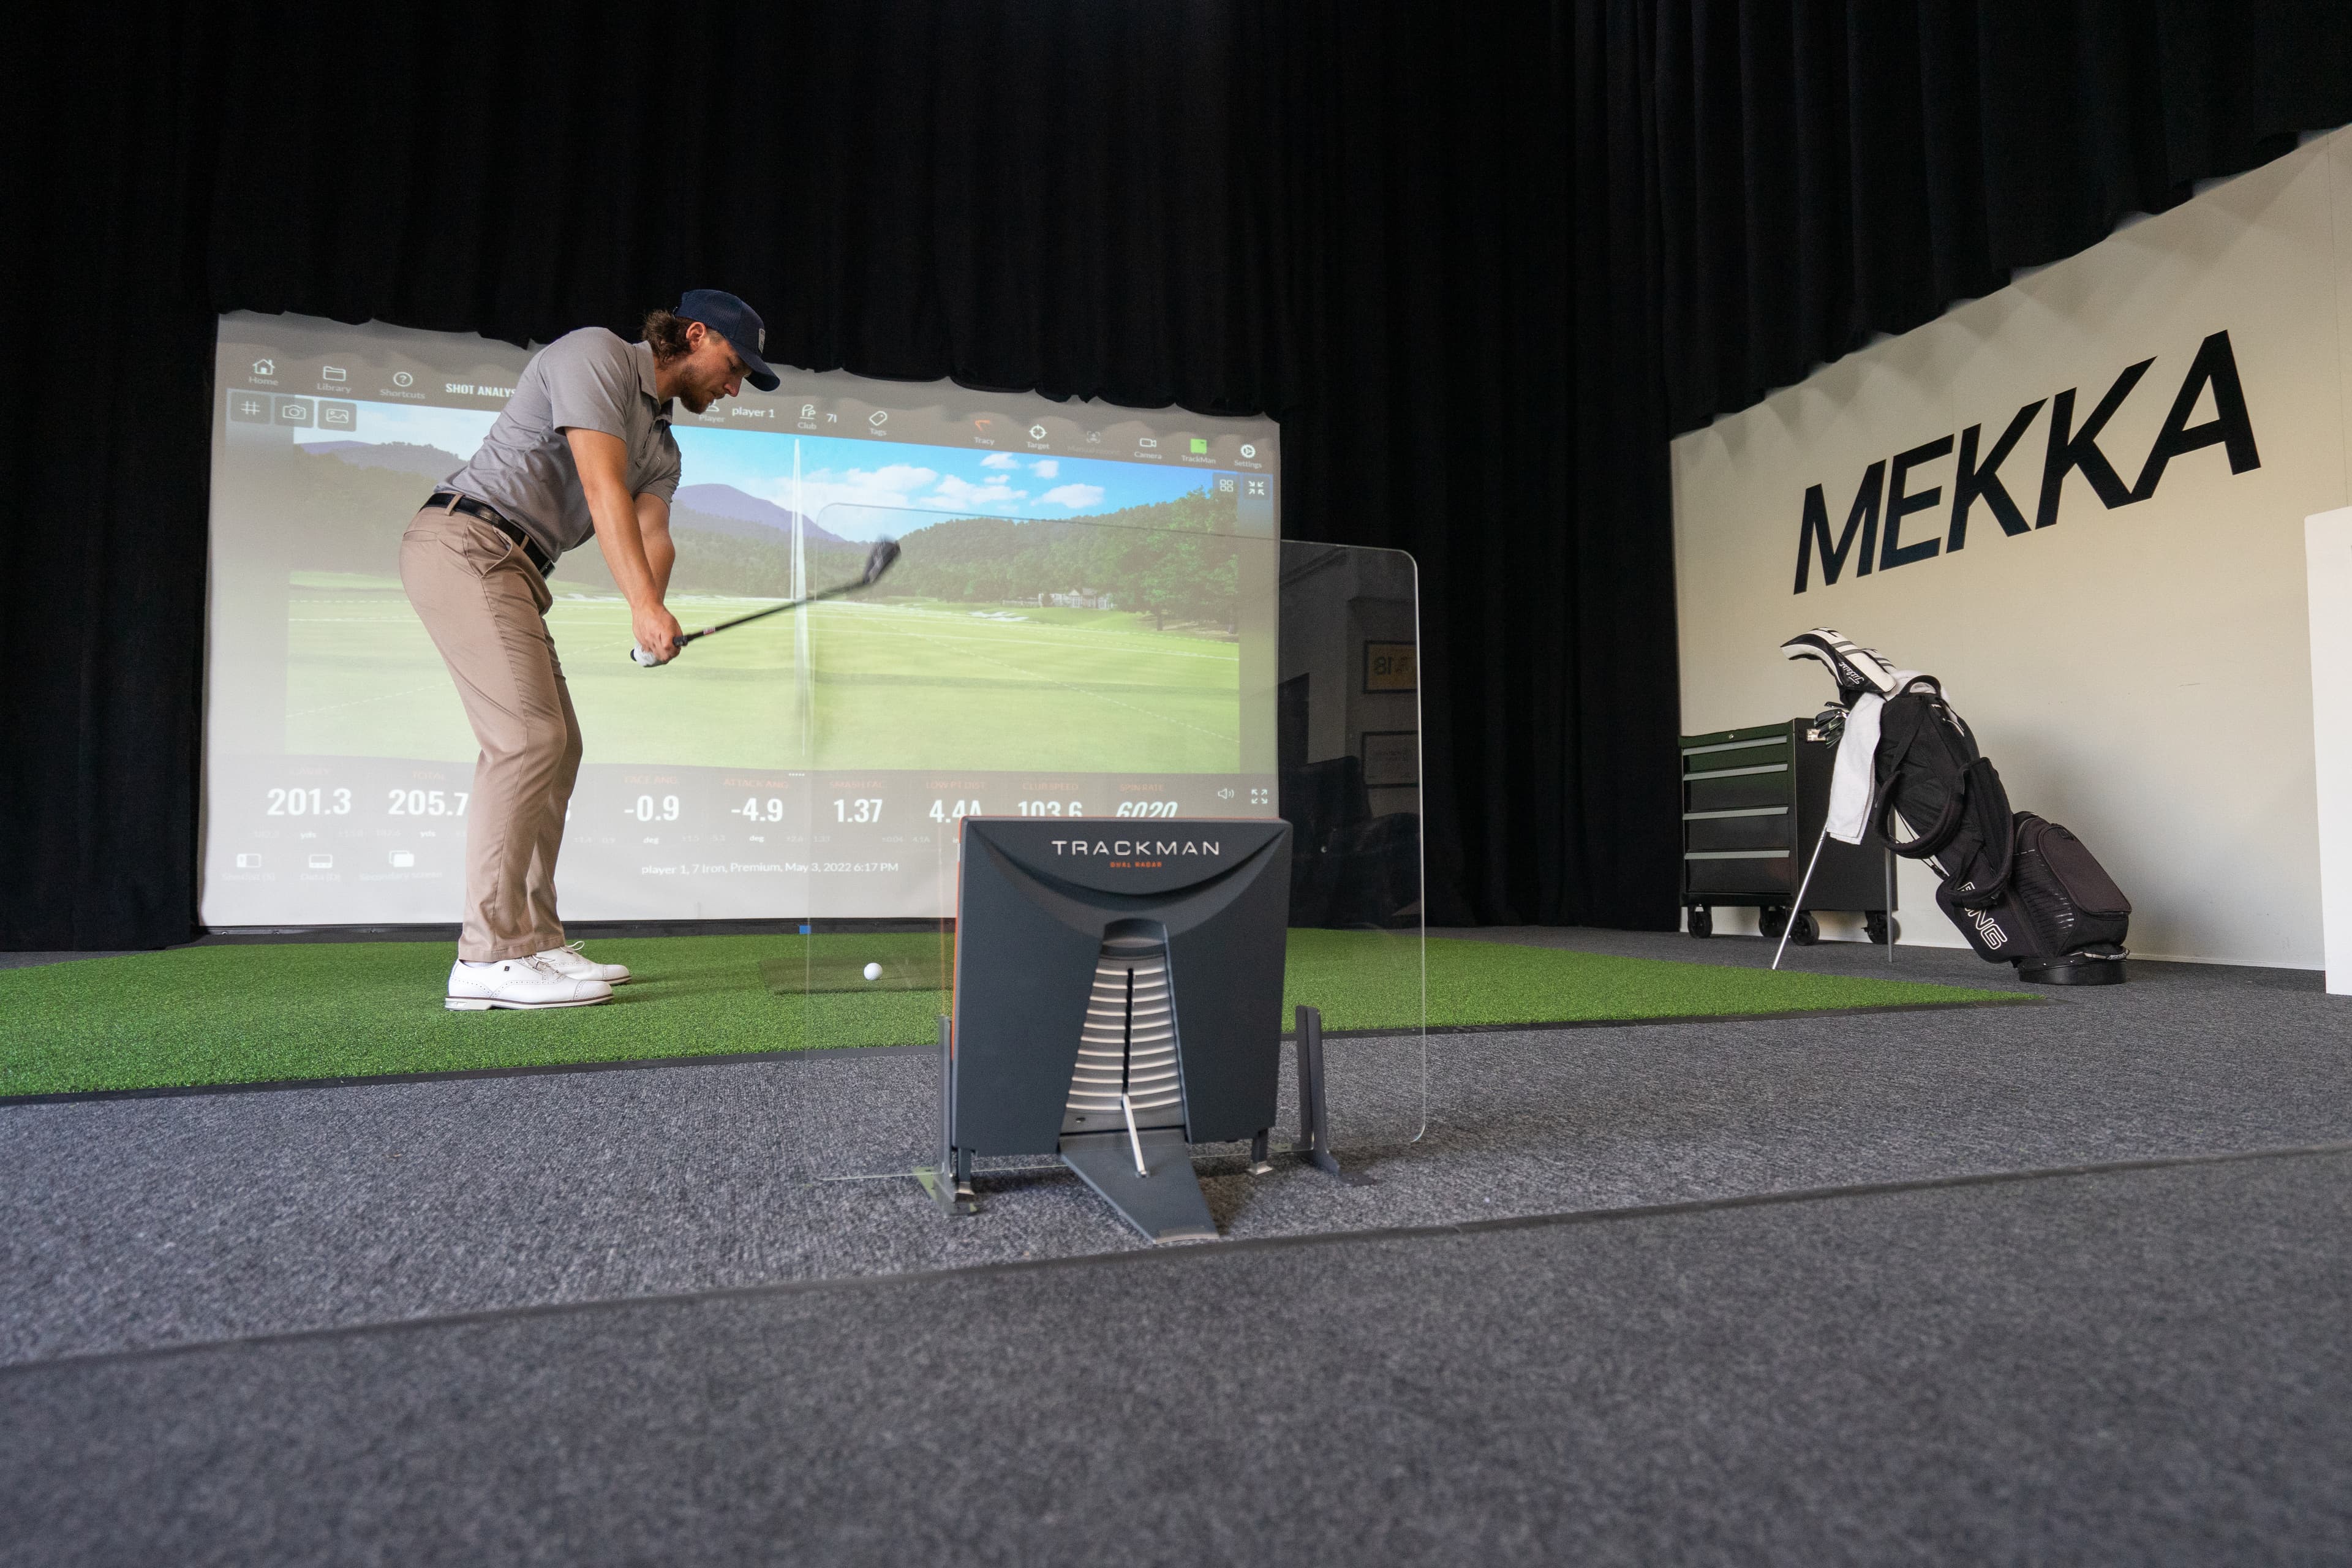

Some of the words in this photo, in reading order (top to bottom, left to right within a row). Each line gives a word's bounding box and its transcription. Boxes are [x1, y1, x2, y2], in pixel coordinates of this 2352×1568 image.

[249, 376, 279, 386] Home
[317, 383, 352, 394] Library
[380, 388, 426, 399] Shortcuts
[445, 383, 475, 394] SHOT
[732, 406, 765, 418] player
[769, 409, 775, 418] 1
[699, 414, 725, 423] Player
[797, 421, 816, 430] Club
[870, 428, 888, 437] Tags
[974, 436, 995, 446] Tracy
[1027, 441, 1050, 450] Target
[1134, 451, 1162, 460] Camera
[1181, 454, 1216, 464] TrackMan
[1234, 459, 1262, 469] Settings
[1793, 330, 2261, 595] MEKKA
[266, 788, 352, 816] 201.3
[387, 789, 469, 816] 205.7
[624, 795, 680, 822] -0.9
[731, 797, 783, 823] -4.9
[833, 799, 883, 823] 1.37
[929, 799, 982, 823] 4.4A
[1017, 801, 1083, 817] 1036
[1116, 801, 1178, 818] 6020
[300, 831, 317, 840] yds
[420, 829, 436, 839] yds
[749, 834, 764, 843] deg
[643, 836, 659, 845] deg
[1051, 840, 1219, 856] TRACKMAN
[641, 864, 677, 876] player
[692, 864, 699, 874] 7
[785, 862, 809, 873] May
[823, 862, 852, 872] 2022
[853, 862, 878, 872] 6:17
[880, 862, 899, 872] PM
